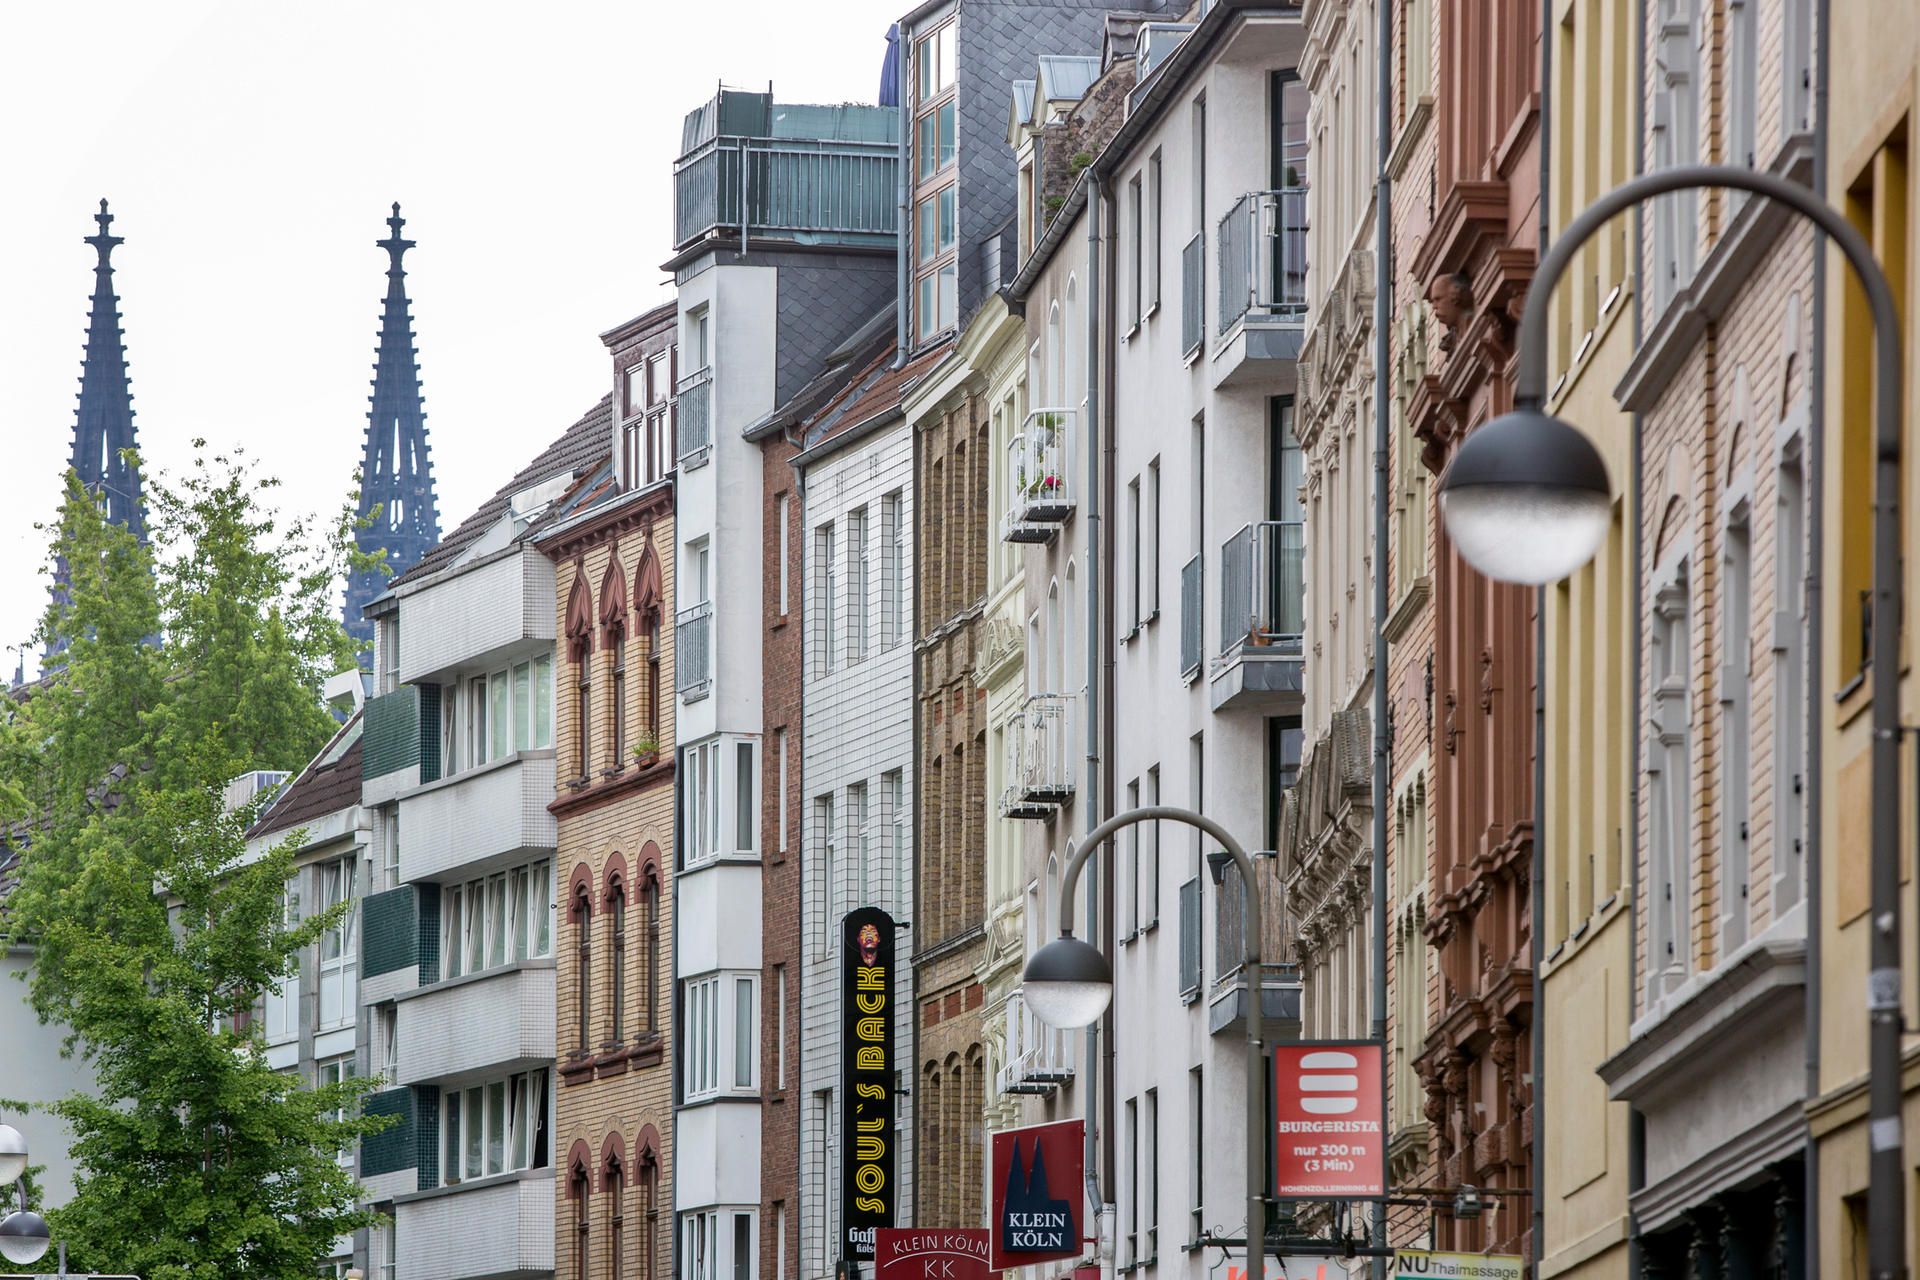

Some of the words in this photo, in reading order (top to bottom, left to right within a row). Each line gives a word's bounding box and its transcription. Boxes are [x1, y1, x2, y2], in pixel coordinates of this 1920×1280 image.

[856, 966, 886, 1070] BACK
[1279, 1121, 1380, 1133] BURGERISTA
[1293, 1145, 1318, 1156] nur
[1320, 1144, 1348, 1156] 300
[1352, 1145, 1366, 1156] m
[1304, 1160, 1320, 1172] (3
[1323, 1159, 1355, 1172] Min)
[1009, 1213, 1066, 1228] KLEIN
[892, 1235, 938, 1255] KLEIN
[943, 1234, 989, 1256] KÖLN
[1012, 1230, 1063, 1247] KÖLN
[1398, 1255, 1429, 1273] NU
[1431, 1262, 1519, 1280] Thaimassage
